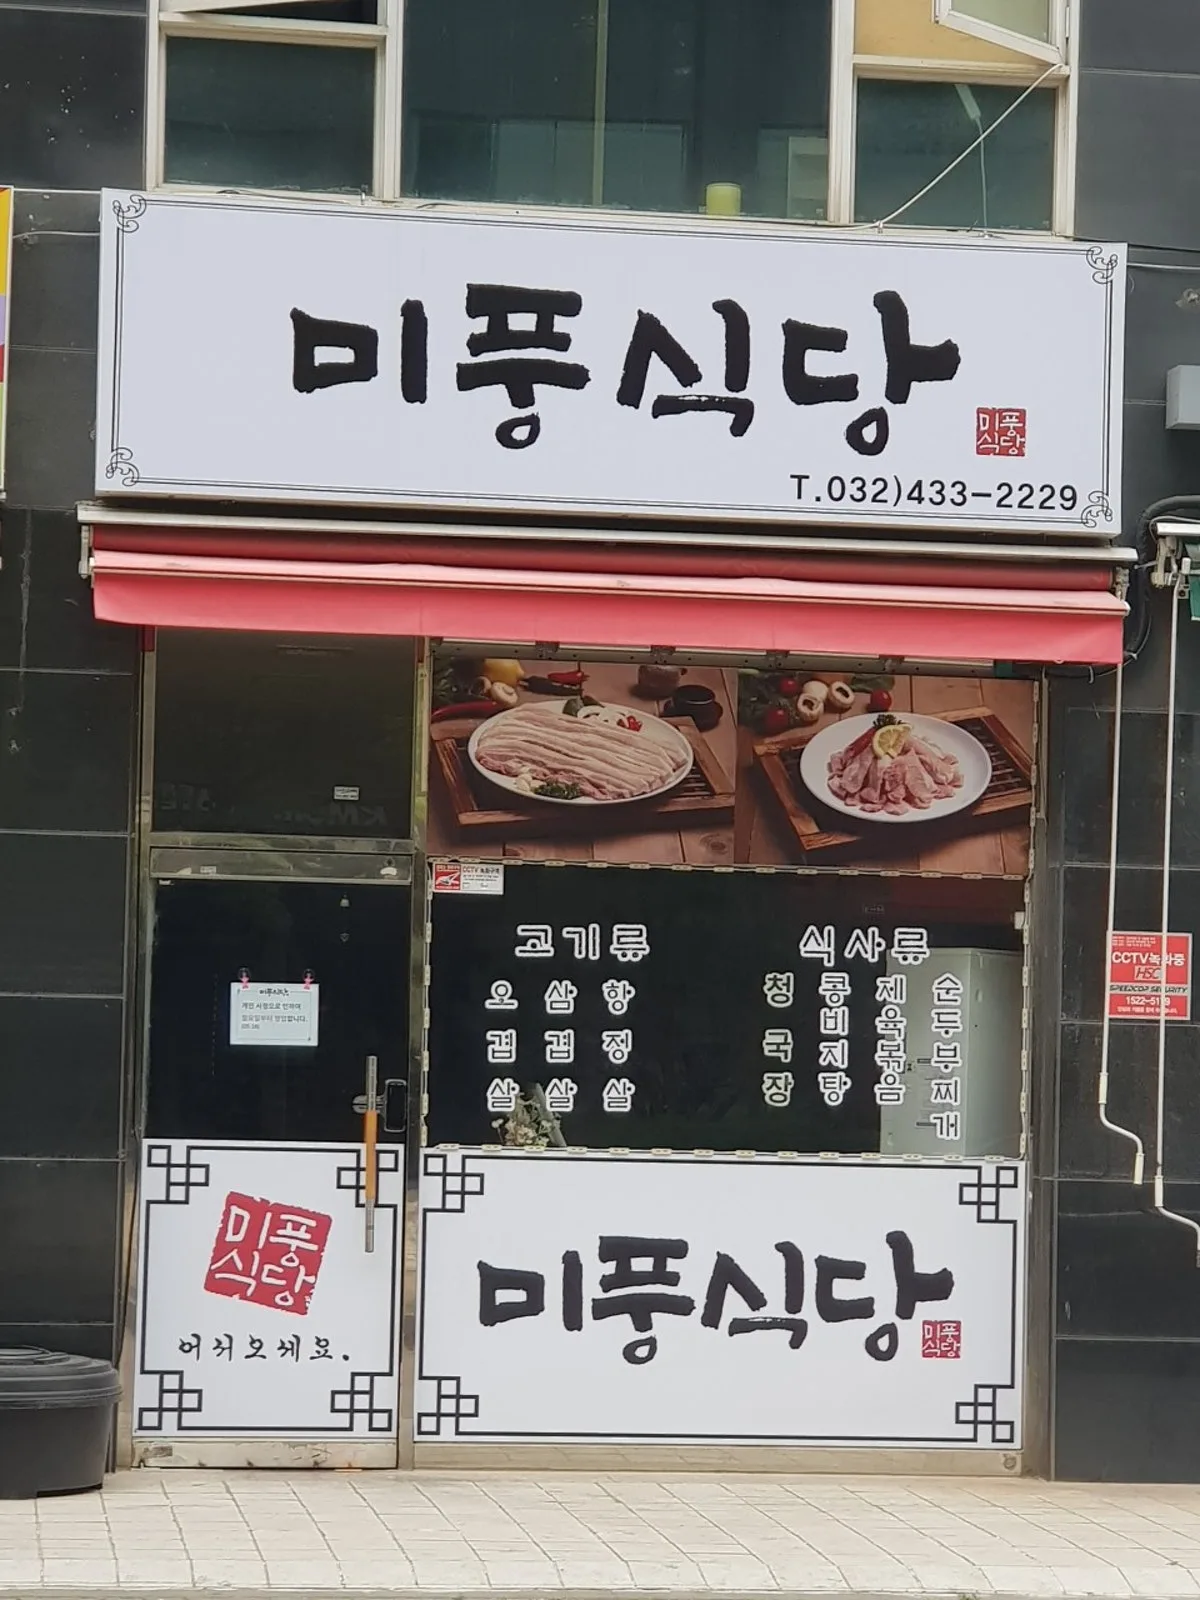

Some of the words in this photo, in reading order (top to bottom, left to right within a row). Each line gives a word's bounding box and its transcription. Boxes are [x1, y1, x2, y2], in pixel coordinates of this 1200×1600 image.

[289, 282, 961, 456] 미풍식당
[976, 431, 1025, 455] 식당
[978, 411, 1024, 436] 미풍
[790, 473, 1078, 511] T.032)433-2229
[515, 923, 650, 961] 고기류
[799, 925, 930, 967] 식사류
[1126, 995, 1171, 1006] 1522-519
[1150, 985, 1188, 994] SEURITY
[485, 980, 520, 1112] 오겹살
[544, 980, 578, 1112] 삼겹살
[602, 979, 635, 1112] 항정살
[762, 972, 795, 1107] 청국장
[818, 972, 851, 1106] 콩비지탕
[874, 974, 907, 1106] 제육볶음
[931, 972, 963, 1140] 순두부찌개
[224, 1204, 319, 1268] 미풍
[210, 1248, 317, 1307] 식당
[477, 1230, 955, 1365] 미풍식당
[922, 1339, 960, 1357] 식당
[924, 1322, 959, 1343] 미풍
